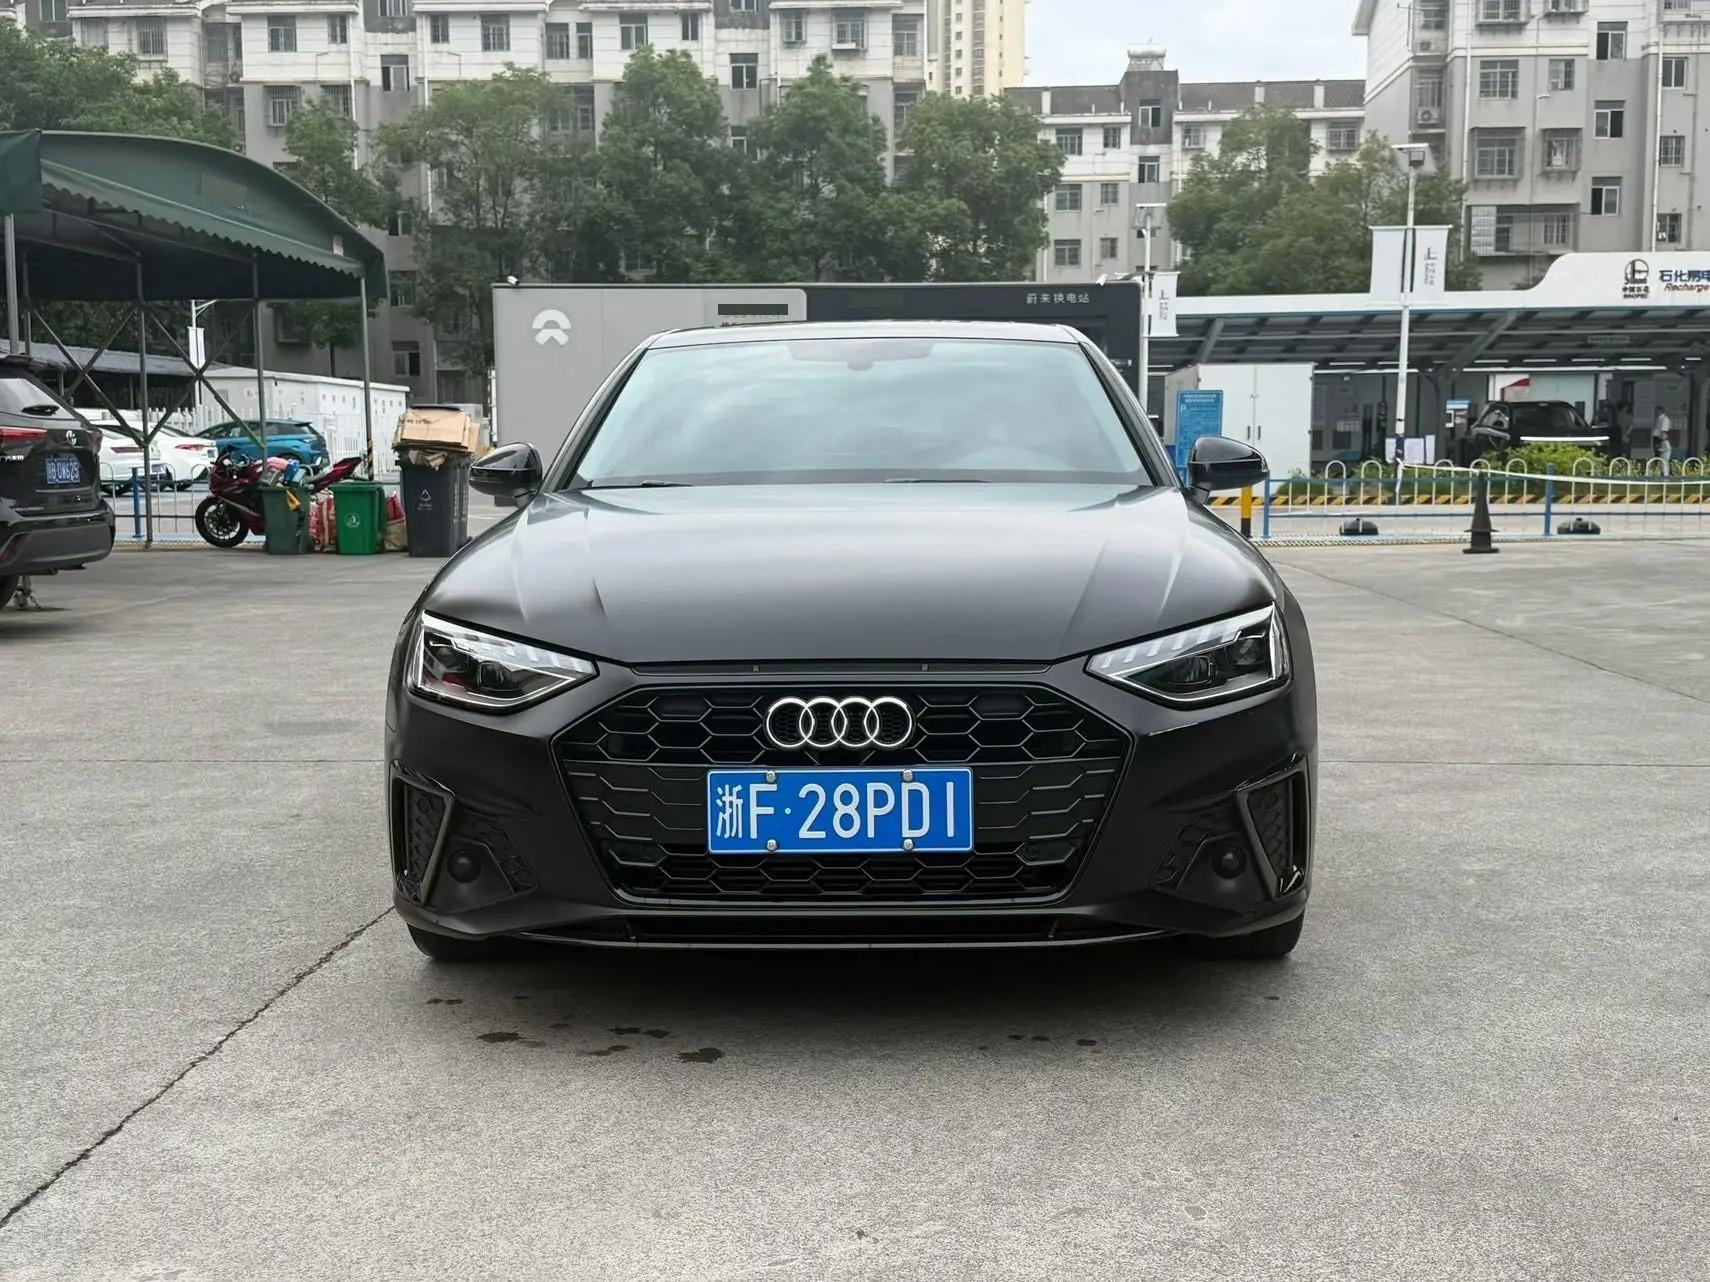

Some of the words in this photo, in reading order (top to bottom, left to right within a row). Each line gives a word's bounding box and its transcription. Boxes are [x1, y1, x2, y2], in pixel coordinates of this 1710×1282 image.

[1026, 292, 1089, 304] 蔚来换电站
